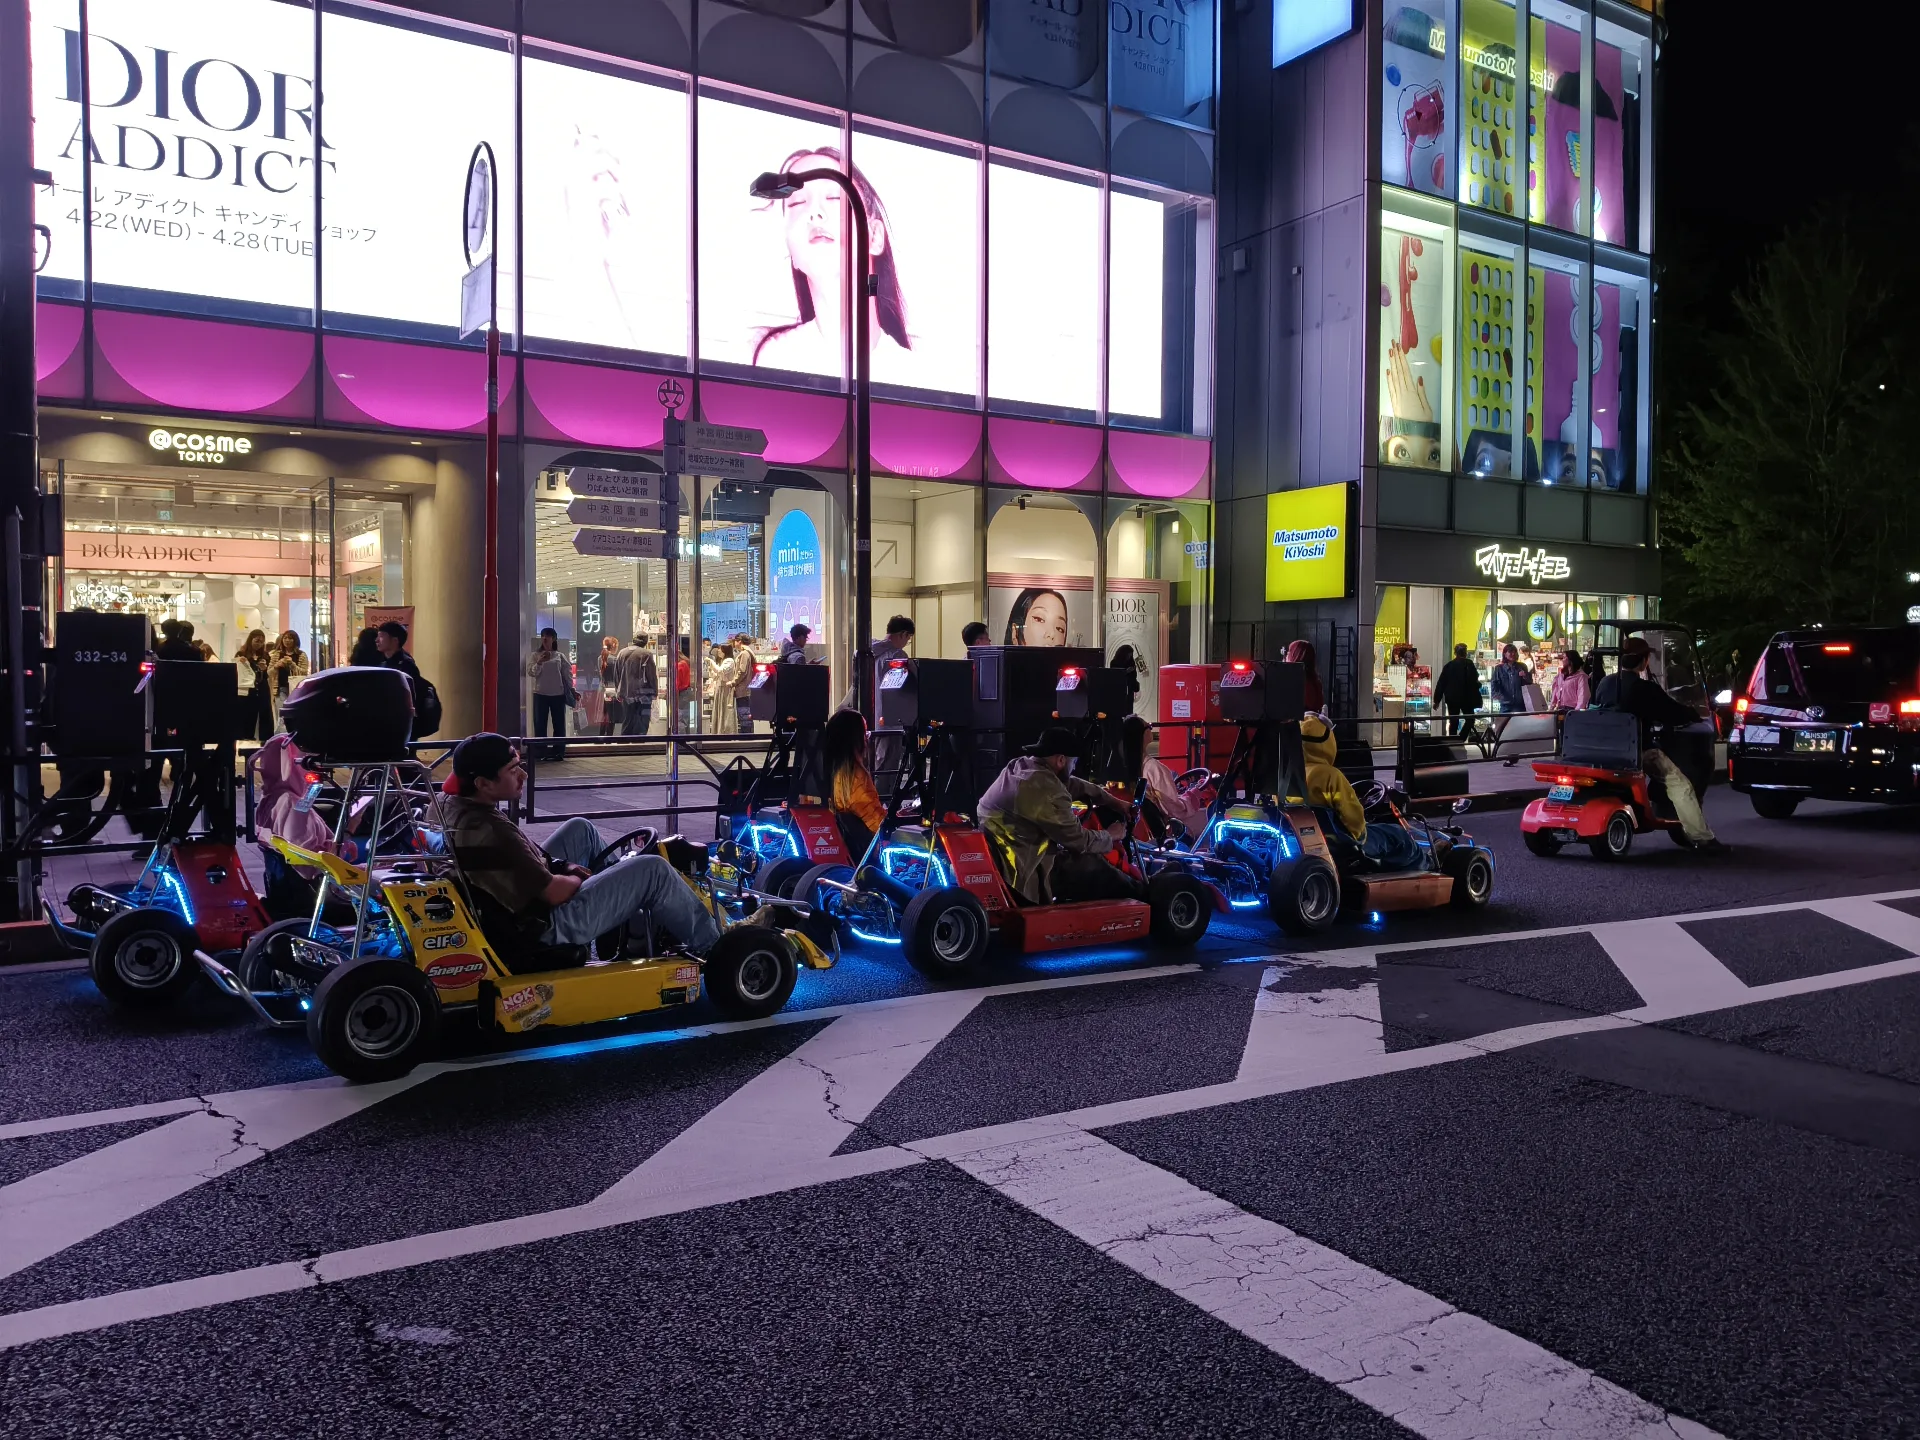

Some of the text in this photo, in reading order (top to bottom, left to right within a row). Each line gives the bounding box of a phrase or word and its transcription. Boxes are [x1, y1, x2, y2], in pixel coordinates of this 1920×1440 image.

[53, 26, 336, 151] DIOR
[57, 117, 336, 199] ADDICT
[114, 188, 206, 218] アディクト
[215, 204, 302, 234] キャンディ
[149, 428, 252, 454] @cosme
[178, 450, 225, 464] TOKYO
[587, 502, 649, 517] 中央図書館
[1274, 526, 1337, 544] Matsumoto
[82, 543, 217, 562] DIOR ADDICT
[1284, 543, 1325, 559] KiYoshi
[1476, 544, 1570, 585] マツモトキヨシ
[582, 592, 600, 633] NARS
[1110, 598, 1146, 613] DIOR
[1110, 613, 1147, 624] ADDICT
[1533, 617, 1544, 632] 薬
[1375, 627, 1400, 635] HEALTH
[1375, 636, 1400, 644] BEAUTY
[74, 650, 127, 662] 332-34
[423, 935, 451, 949] elf
[428, 962, 483, 977] Snap-on
[503, 987, 534, 1010] NGK
